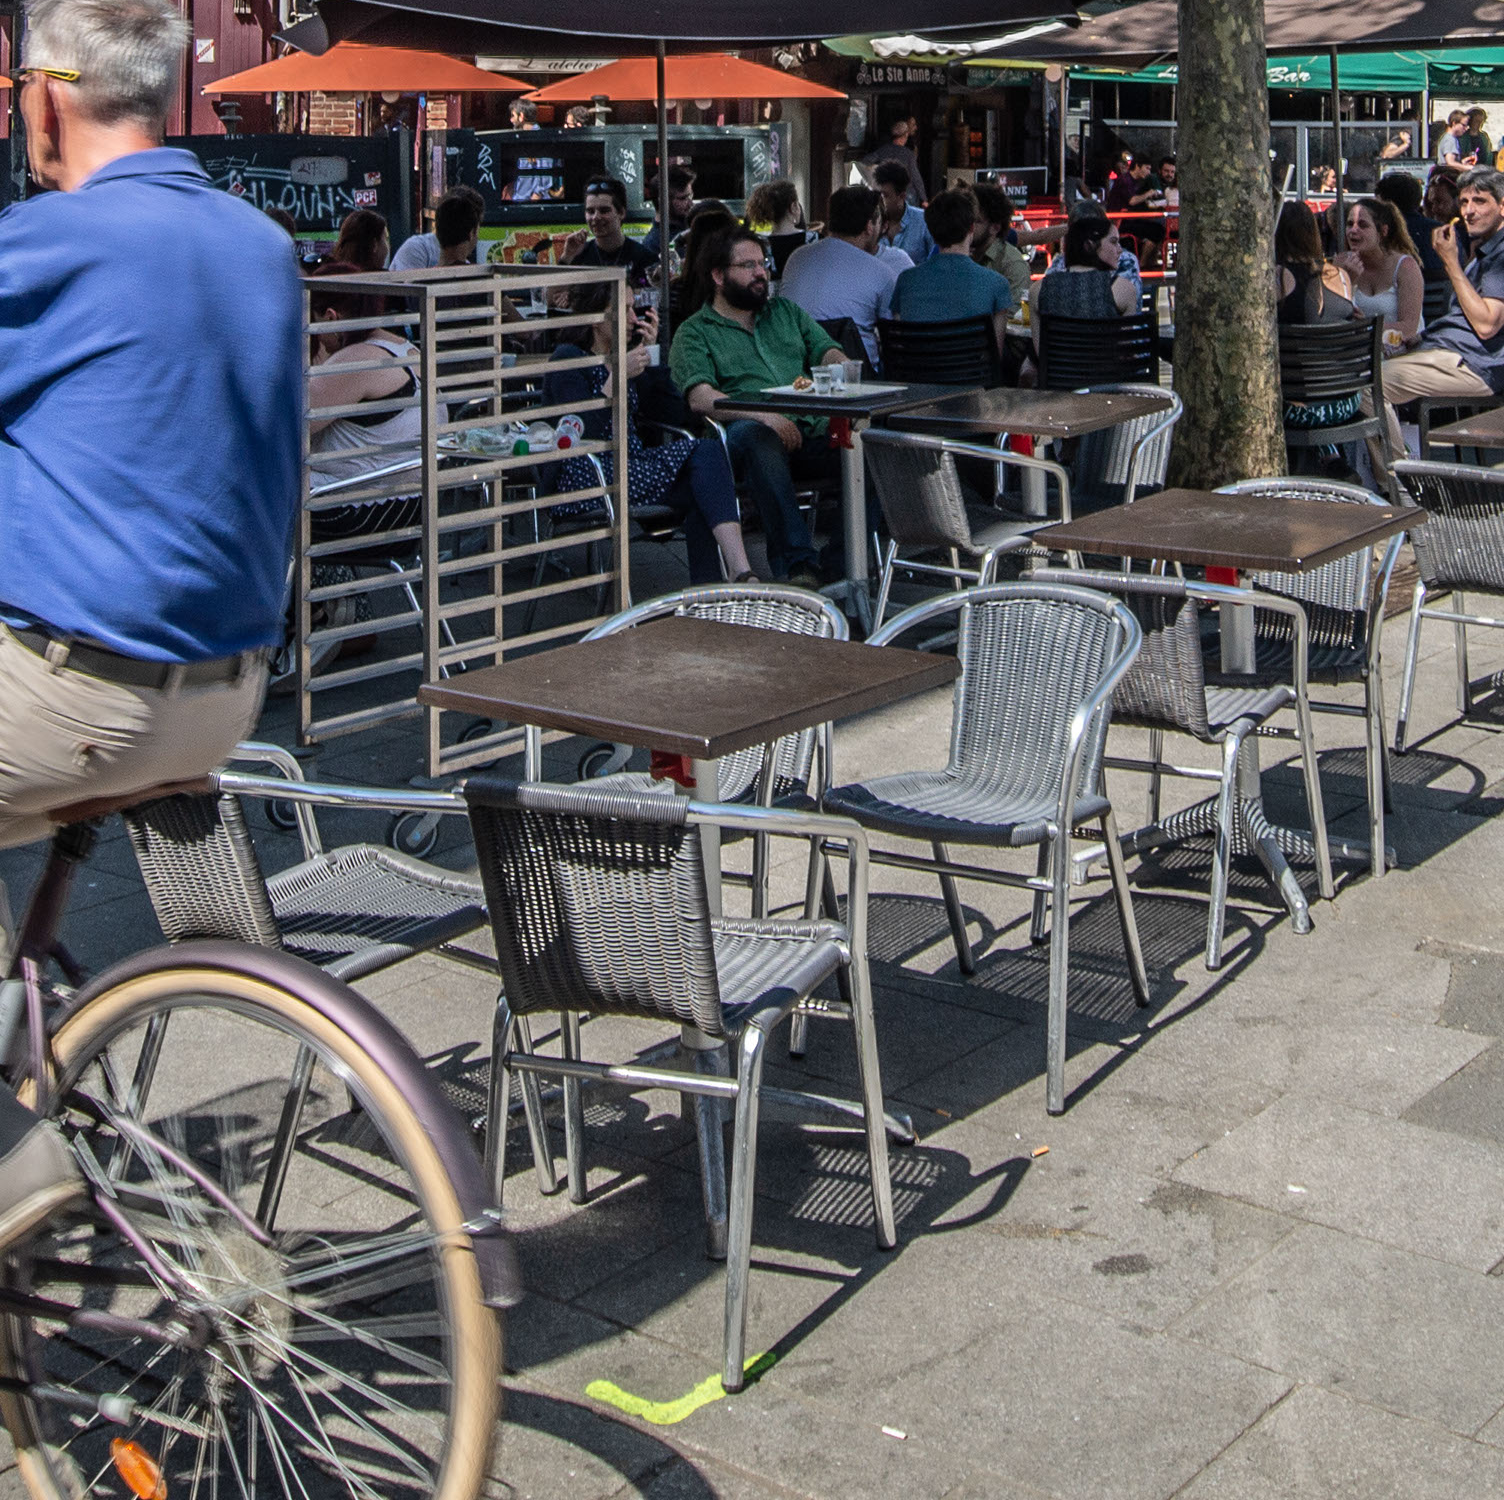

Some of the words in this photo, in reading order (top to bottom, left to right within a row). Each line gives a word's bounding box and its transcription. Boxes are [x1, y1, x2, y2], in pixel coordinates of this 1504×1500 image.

[872, 67, 884, 82] Le
[886, 66, 904, 82] Ste
[906, 67, 931, 82] Anne
[1267, 66, 1312, 83] Bar
